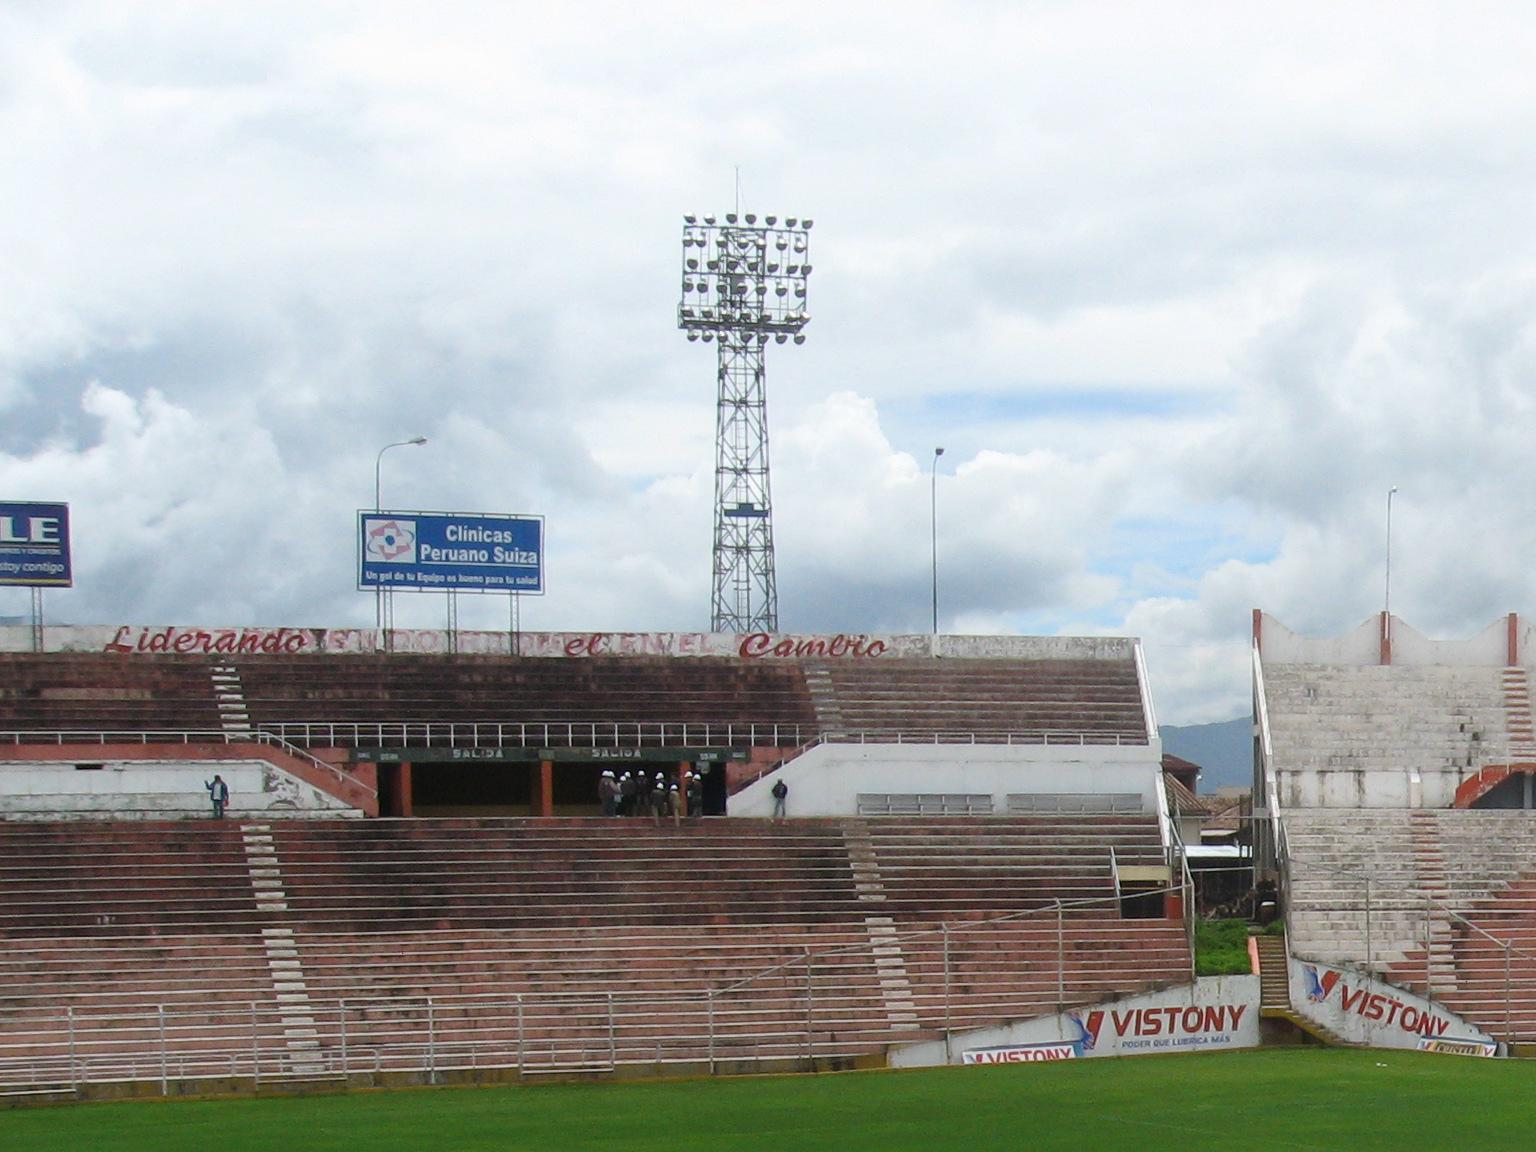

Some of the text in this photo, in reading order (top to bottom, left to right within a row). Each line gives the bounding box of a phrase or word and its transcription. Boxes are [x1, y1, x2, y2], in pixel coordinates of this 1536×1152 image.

[446, 525, 512, 543] Clínicas
[420, 544, 538, 564] Peruano Suiza
[22, 562, 65, 575] contigo
[365, 571, 378, 580] Un
[394, 572, 405, 580] de
[406, 572, 416, 580] tu
[417, 572, 445, 583] Equipo
[485, 576, 504, 585] para
[505, 575, 515, 584] tu
[103, 625, 309, 654] Liderando
[738, 632, 889, 658] Cambio
[452, 749, 504, 758] SALIDA
[591, 748, 642, 758] SALIDA
[1340, 984, 1450, 1037] VISTONY
[1111, 1004, 1248, 1037] VISTONY
[1121, 1040, 1152, 1049] PODER
[1153, 1039, 1171, 1047] QUE
[1172, 1036, 1208, 1046] LUBRICA
[986, 1047, 1072, 1063] VISTONY
